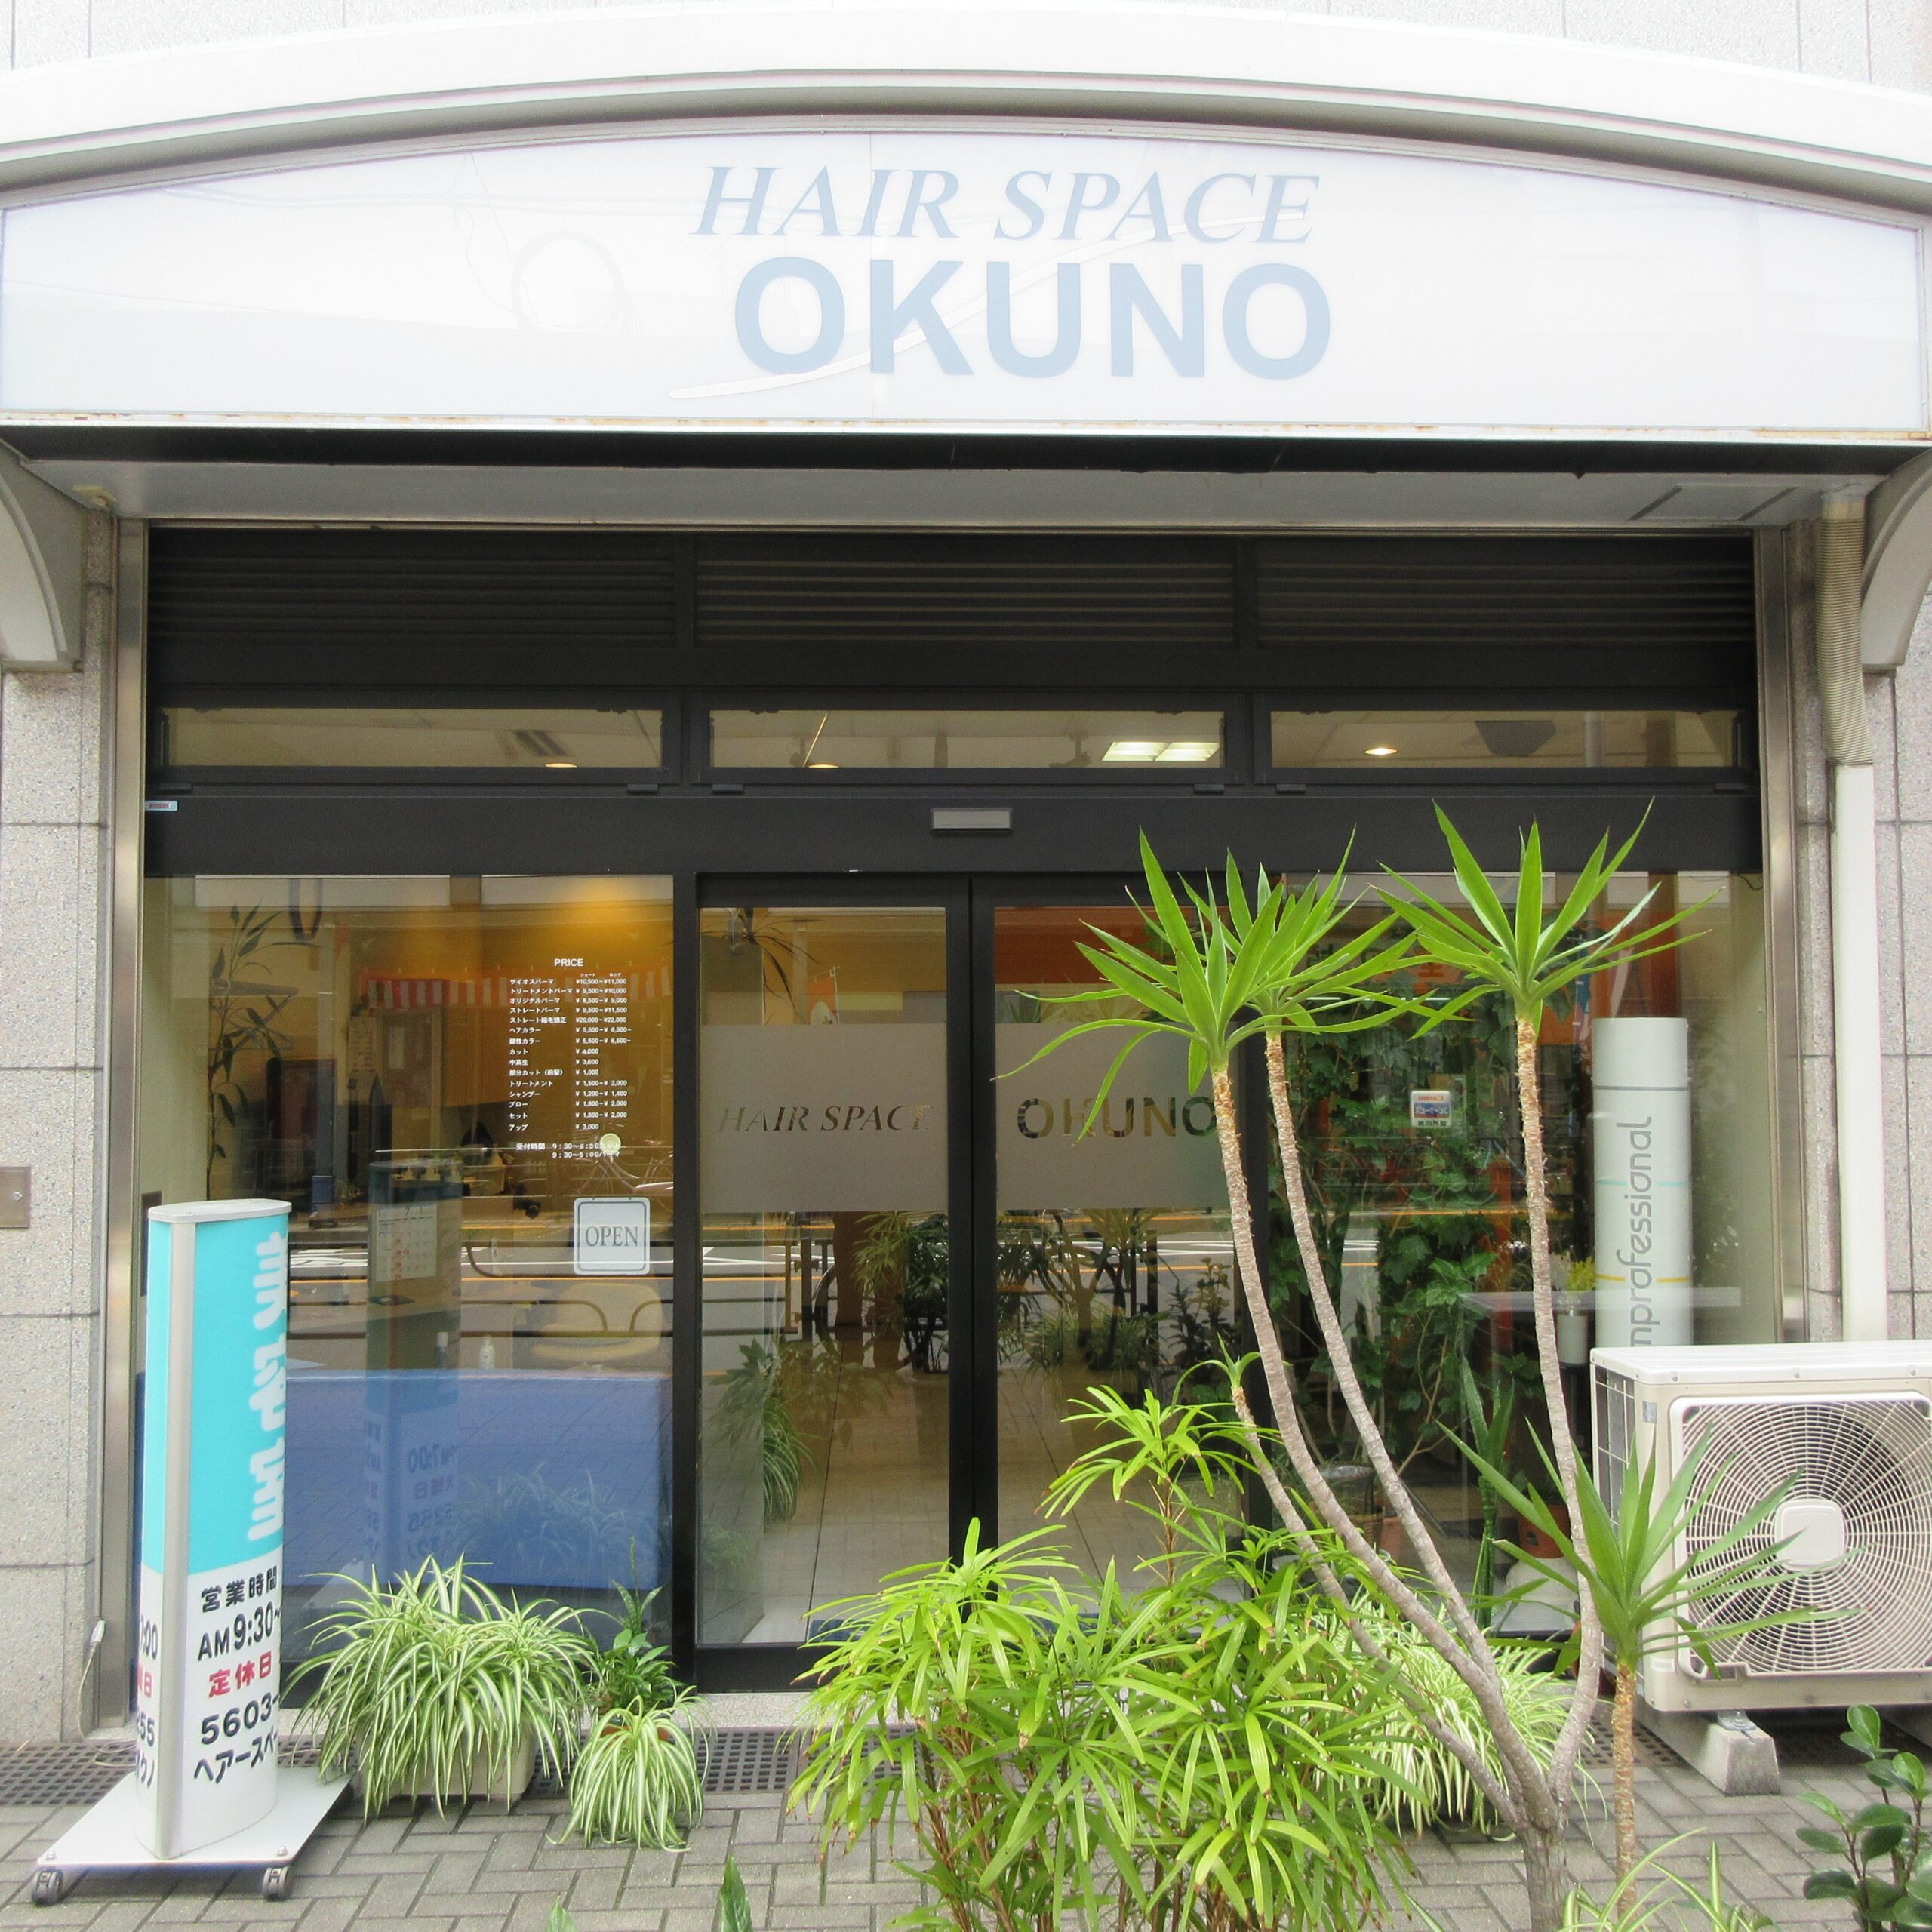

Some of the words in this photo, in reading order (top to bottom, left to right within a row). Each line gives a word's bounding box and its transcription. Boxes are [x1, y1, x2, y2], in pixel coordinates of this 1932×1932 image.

[688, 165, 960, 239] HAIR
[992, 170, 1321, 244] SPACE
[734, 255, 1331, 380] OKUNO
[554, 958, 583, 967] PRICE
[719, 1106, 810, 1132] HAIR
[1017, 1096, 1218, 1139] OKUNO
[585, 1226, 638, 1247] OPEN
[201, 1564, 278, 1612] 営業時間
[208, 1650, 272, 1698] 定休日
